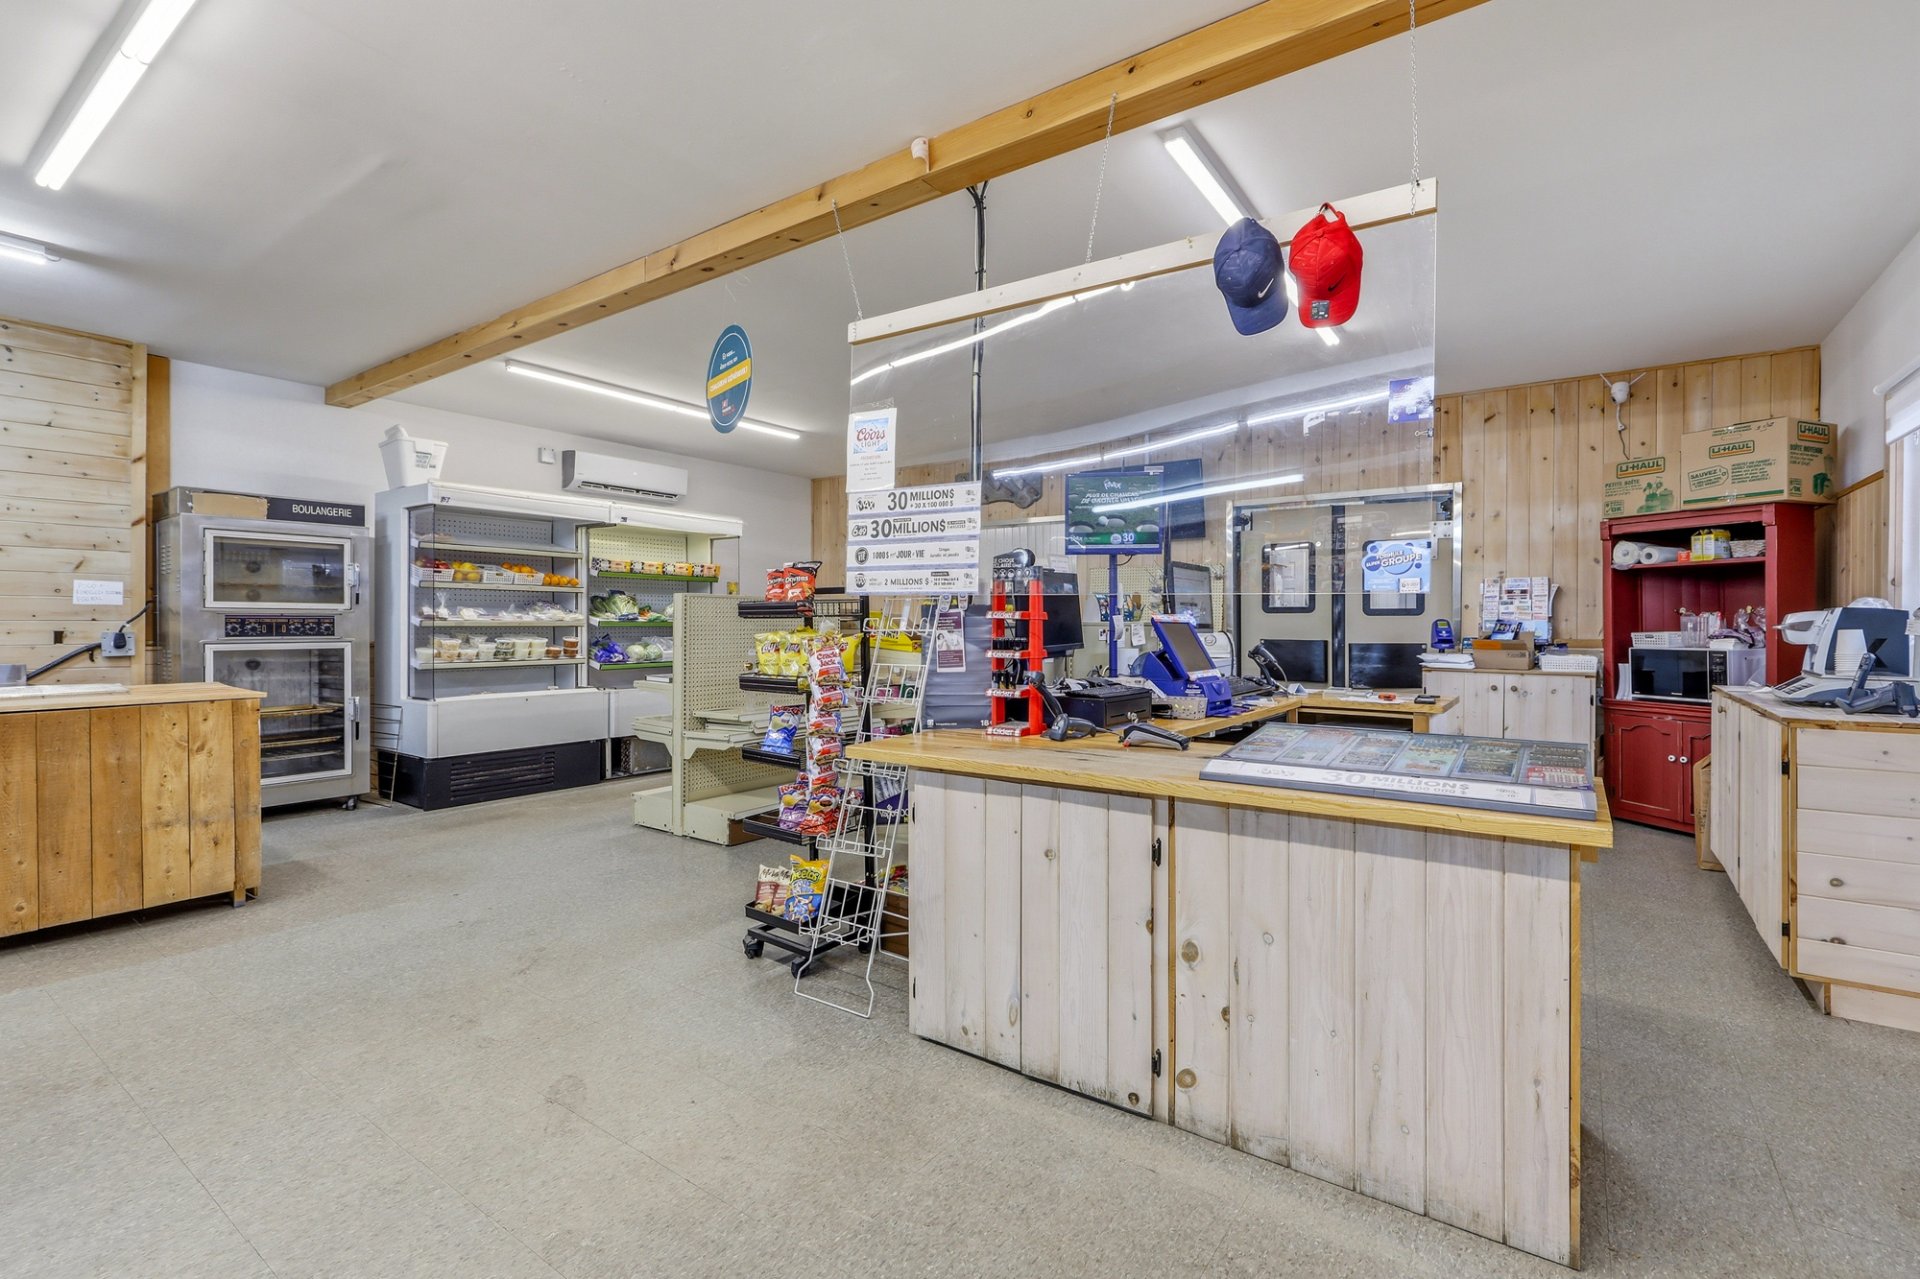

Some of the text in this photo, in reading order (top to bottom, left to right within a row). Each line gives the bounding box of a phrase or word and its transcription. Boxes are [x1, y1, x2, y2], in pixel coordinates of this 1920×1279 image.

[857, 428, 885, 441] Coors
[1800, 424, 1829, 436] U-HAUL
[861, 440, 880, 448] LIGHT
[1712, 443, 1752, 453] U-HAUL
[1620, 460, 1662, 472] U-HAUL
[888, 491, 908, 511] 30
[292, 504, 352, 518] BOULANGERIE
[870, 519, 892, 538] 30
[1122, 532, 1135, 542] 30
[1381, 553, 1423, 568] GROUPE
[890, 578, 923, 586] MILLIONS
[1321, 769, 1366, 787] 30
